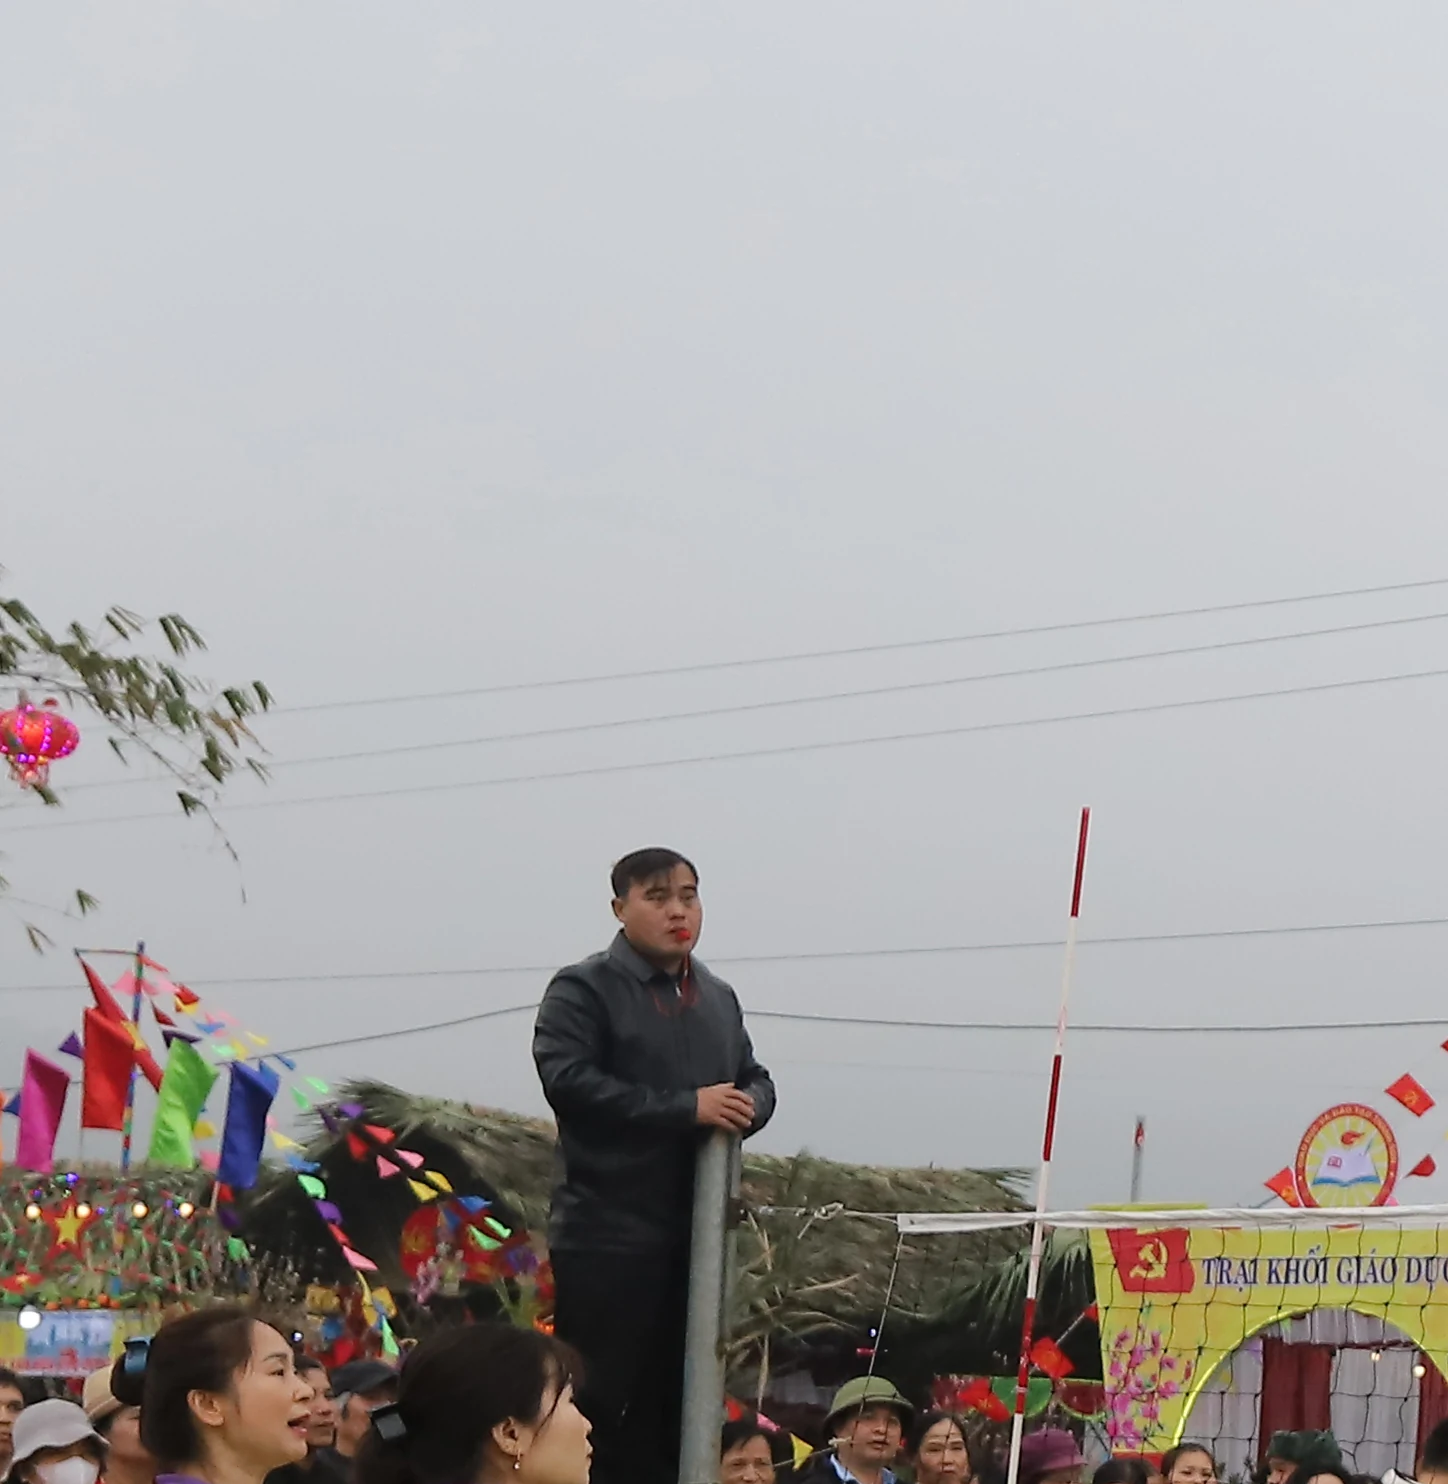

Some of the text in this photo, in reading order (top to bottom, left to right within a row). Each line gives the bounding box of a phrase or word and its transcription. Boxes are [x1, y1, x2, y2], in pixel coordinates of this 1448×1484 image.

[1202, 1257, 1258, 1293] TRẠI
[1266, 1245, 1329, 1285] KHỐI
[1336, 1248, 1397, 1285] GIÁO
